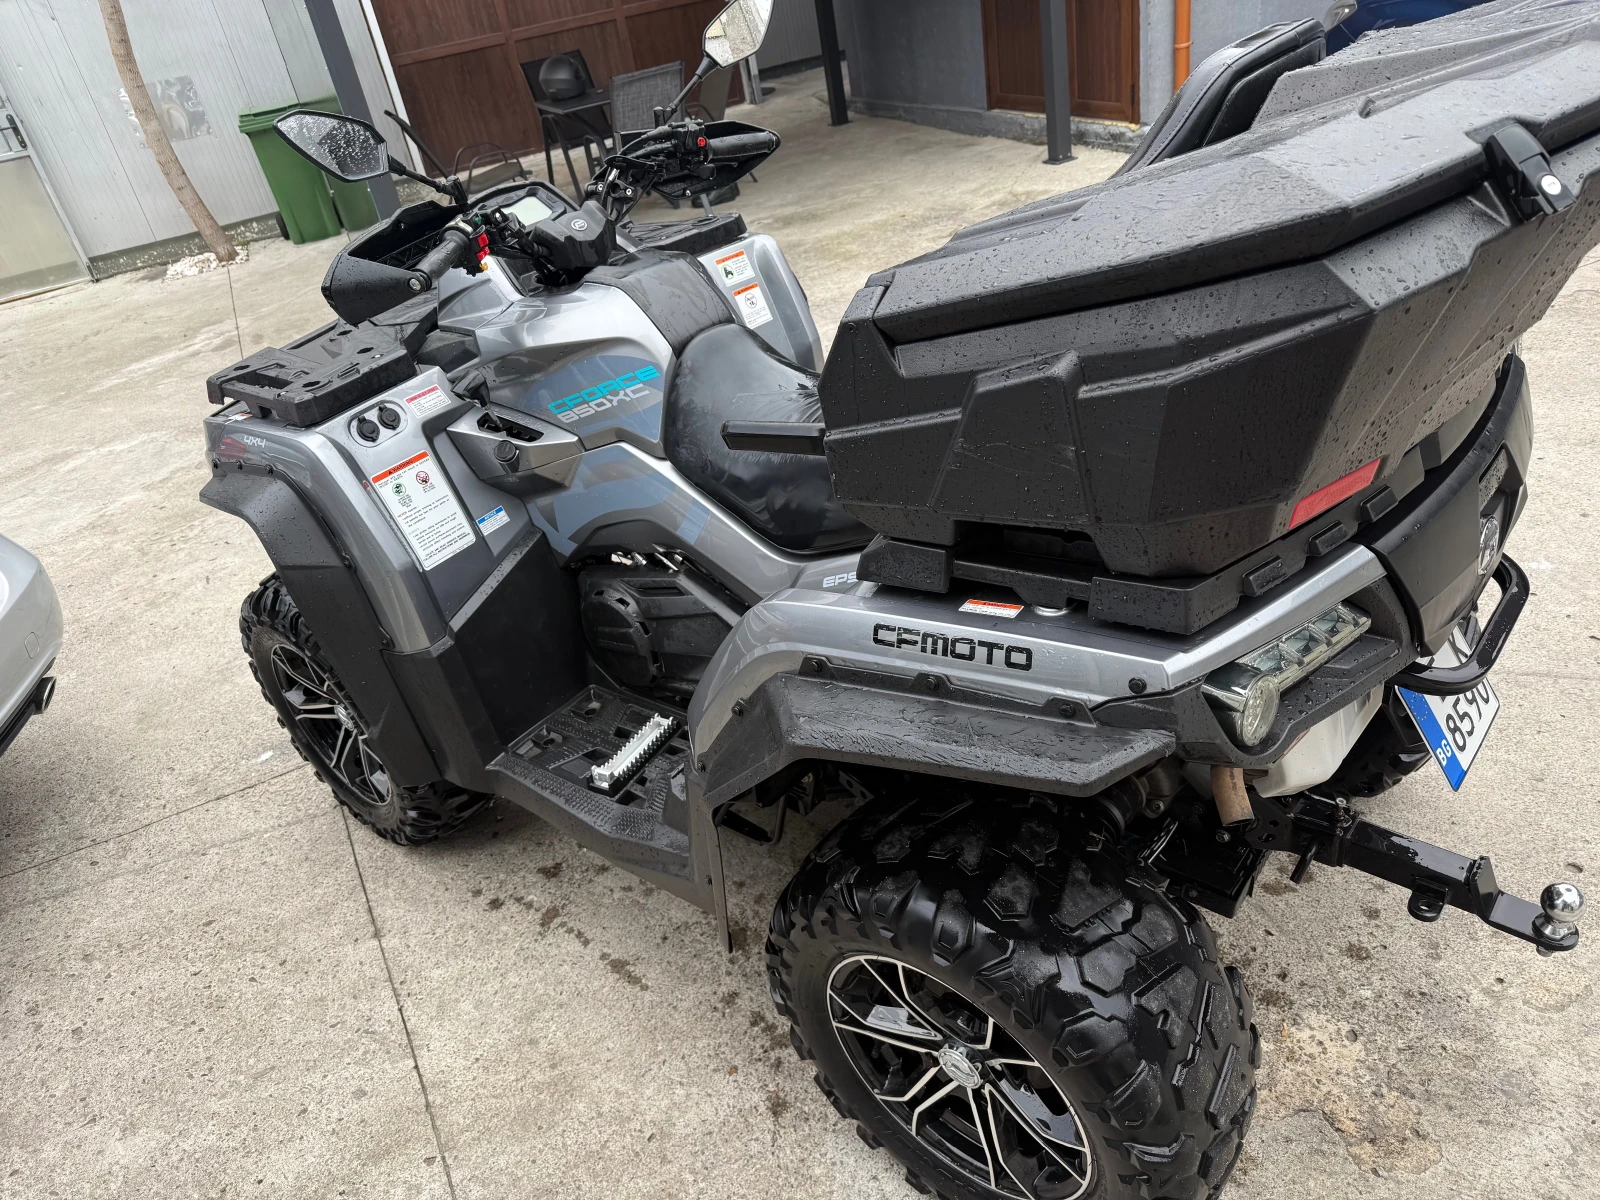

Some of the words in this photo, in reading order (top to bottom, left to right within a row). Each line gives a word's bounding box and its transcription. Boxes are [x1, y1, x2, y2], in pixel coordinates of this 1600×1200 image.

[548, 365, 660, 415] CFORCE
[557, 383, 650, 423] 850XC
[822, 571, 859, 588] EPS
[873, 623, 1033, 672] CFMOTO
[1436, 739, 1452, 767] BG
